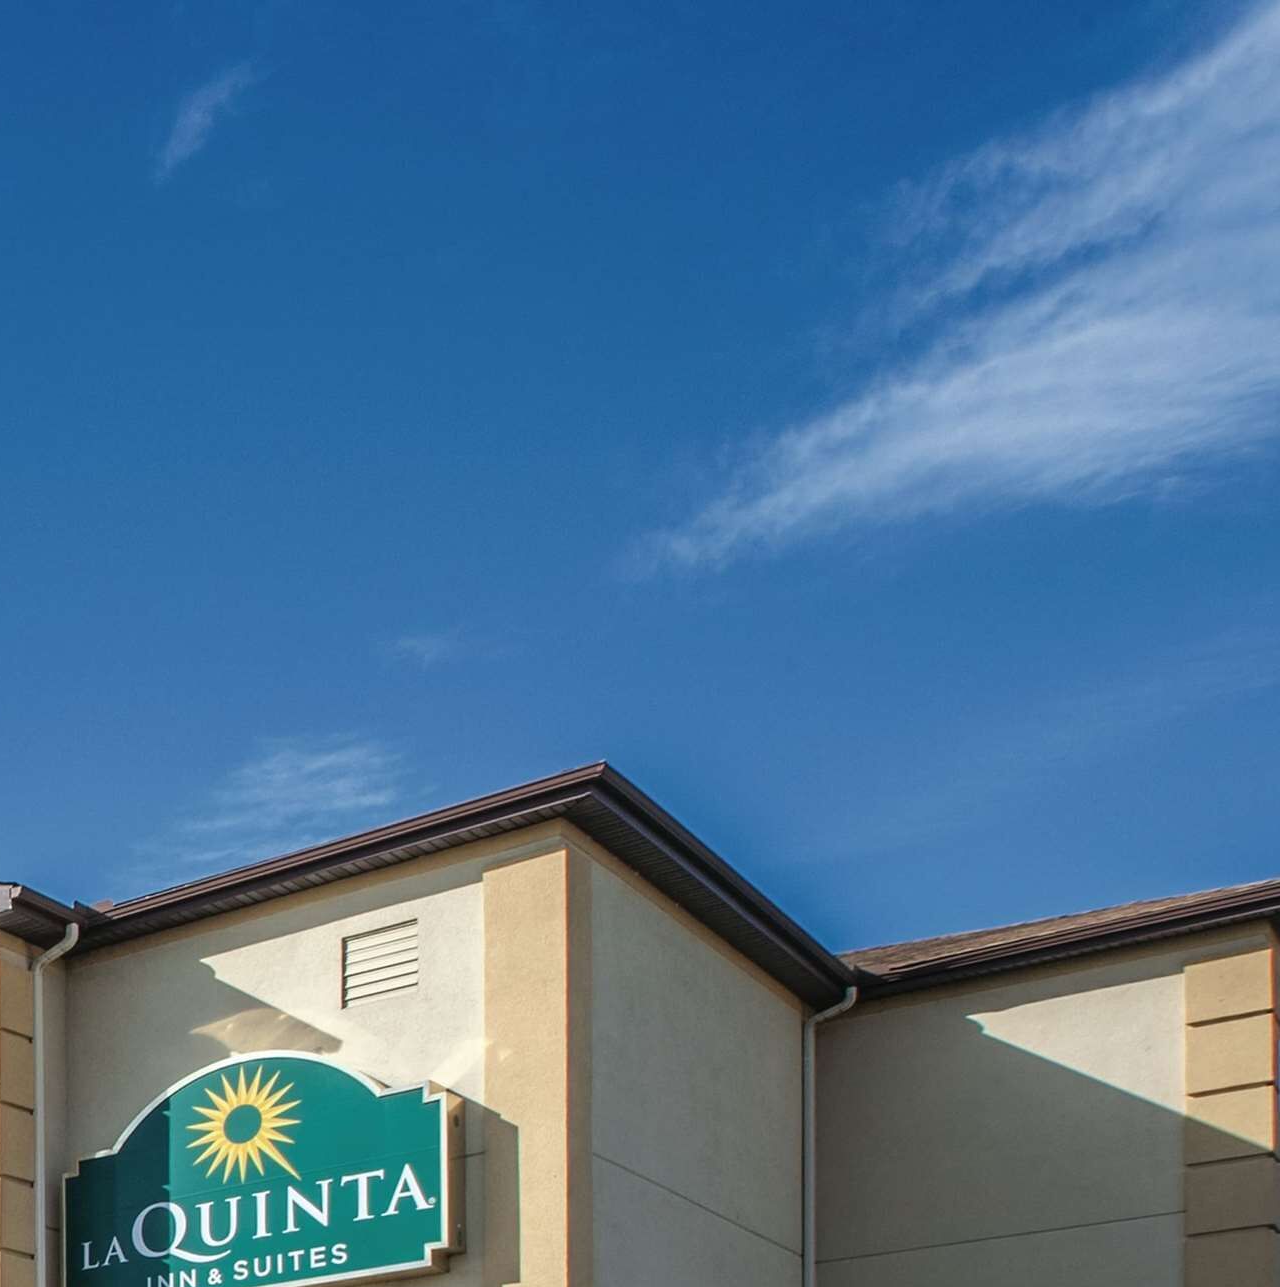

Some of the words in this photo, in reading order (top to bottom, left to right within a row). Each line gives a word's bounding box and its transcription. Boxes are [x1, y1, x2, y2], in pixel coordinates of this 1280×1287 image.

[82, 1238, 129, 1270] LA
[132, 1163, 435, 1263] QUINTA
[207, 1267, 223, 1286] &
[233, 1243, 348, 1281] SUITES
